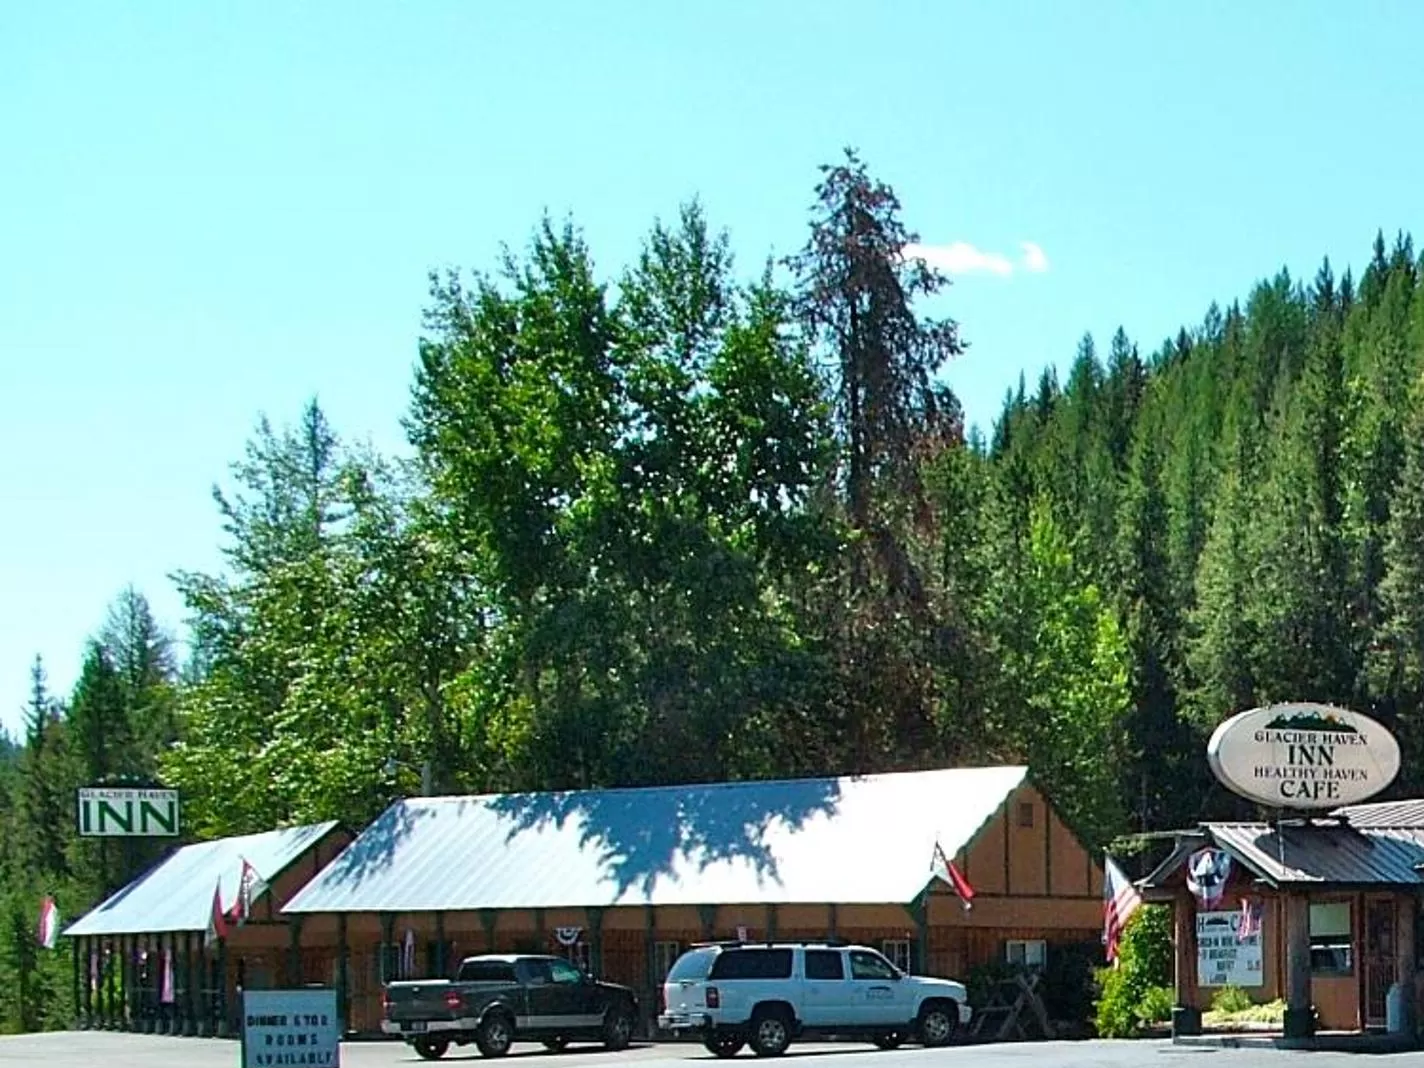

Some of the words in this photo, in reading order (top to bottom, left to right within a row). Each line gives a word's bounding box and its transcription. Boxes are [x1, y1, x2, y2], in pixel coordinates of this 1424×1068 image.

[1253, 730, 1317, 744] GLACIER
[1322, 733, 1368, 745] HAVEN
[1288, 744, 1335, 766] INN
[1253, 766, 1319, 779] HEALTHY
[1323, 768, 1368, 780] HAVEN
[1280, 780, 1340, 800] CAFE
[83, 800, 175, 833] INN
[265, 1033, 319, 1046] ROOMS
